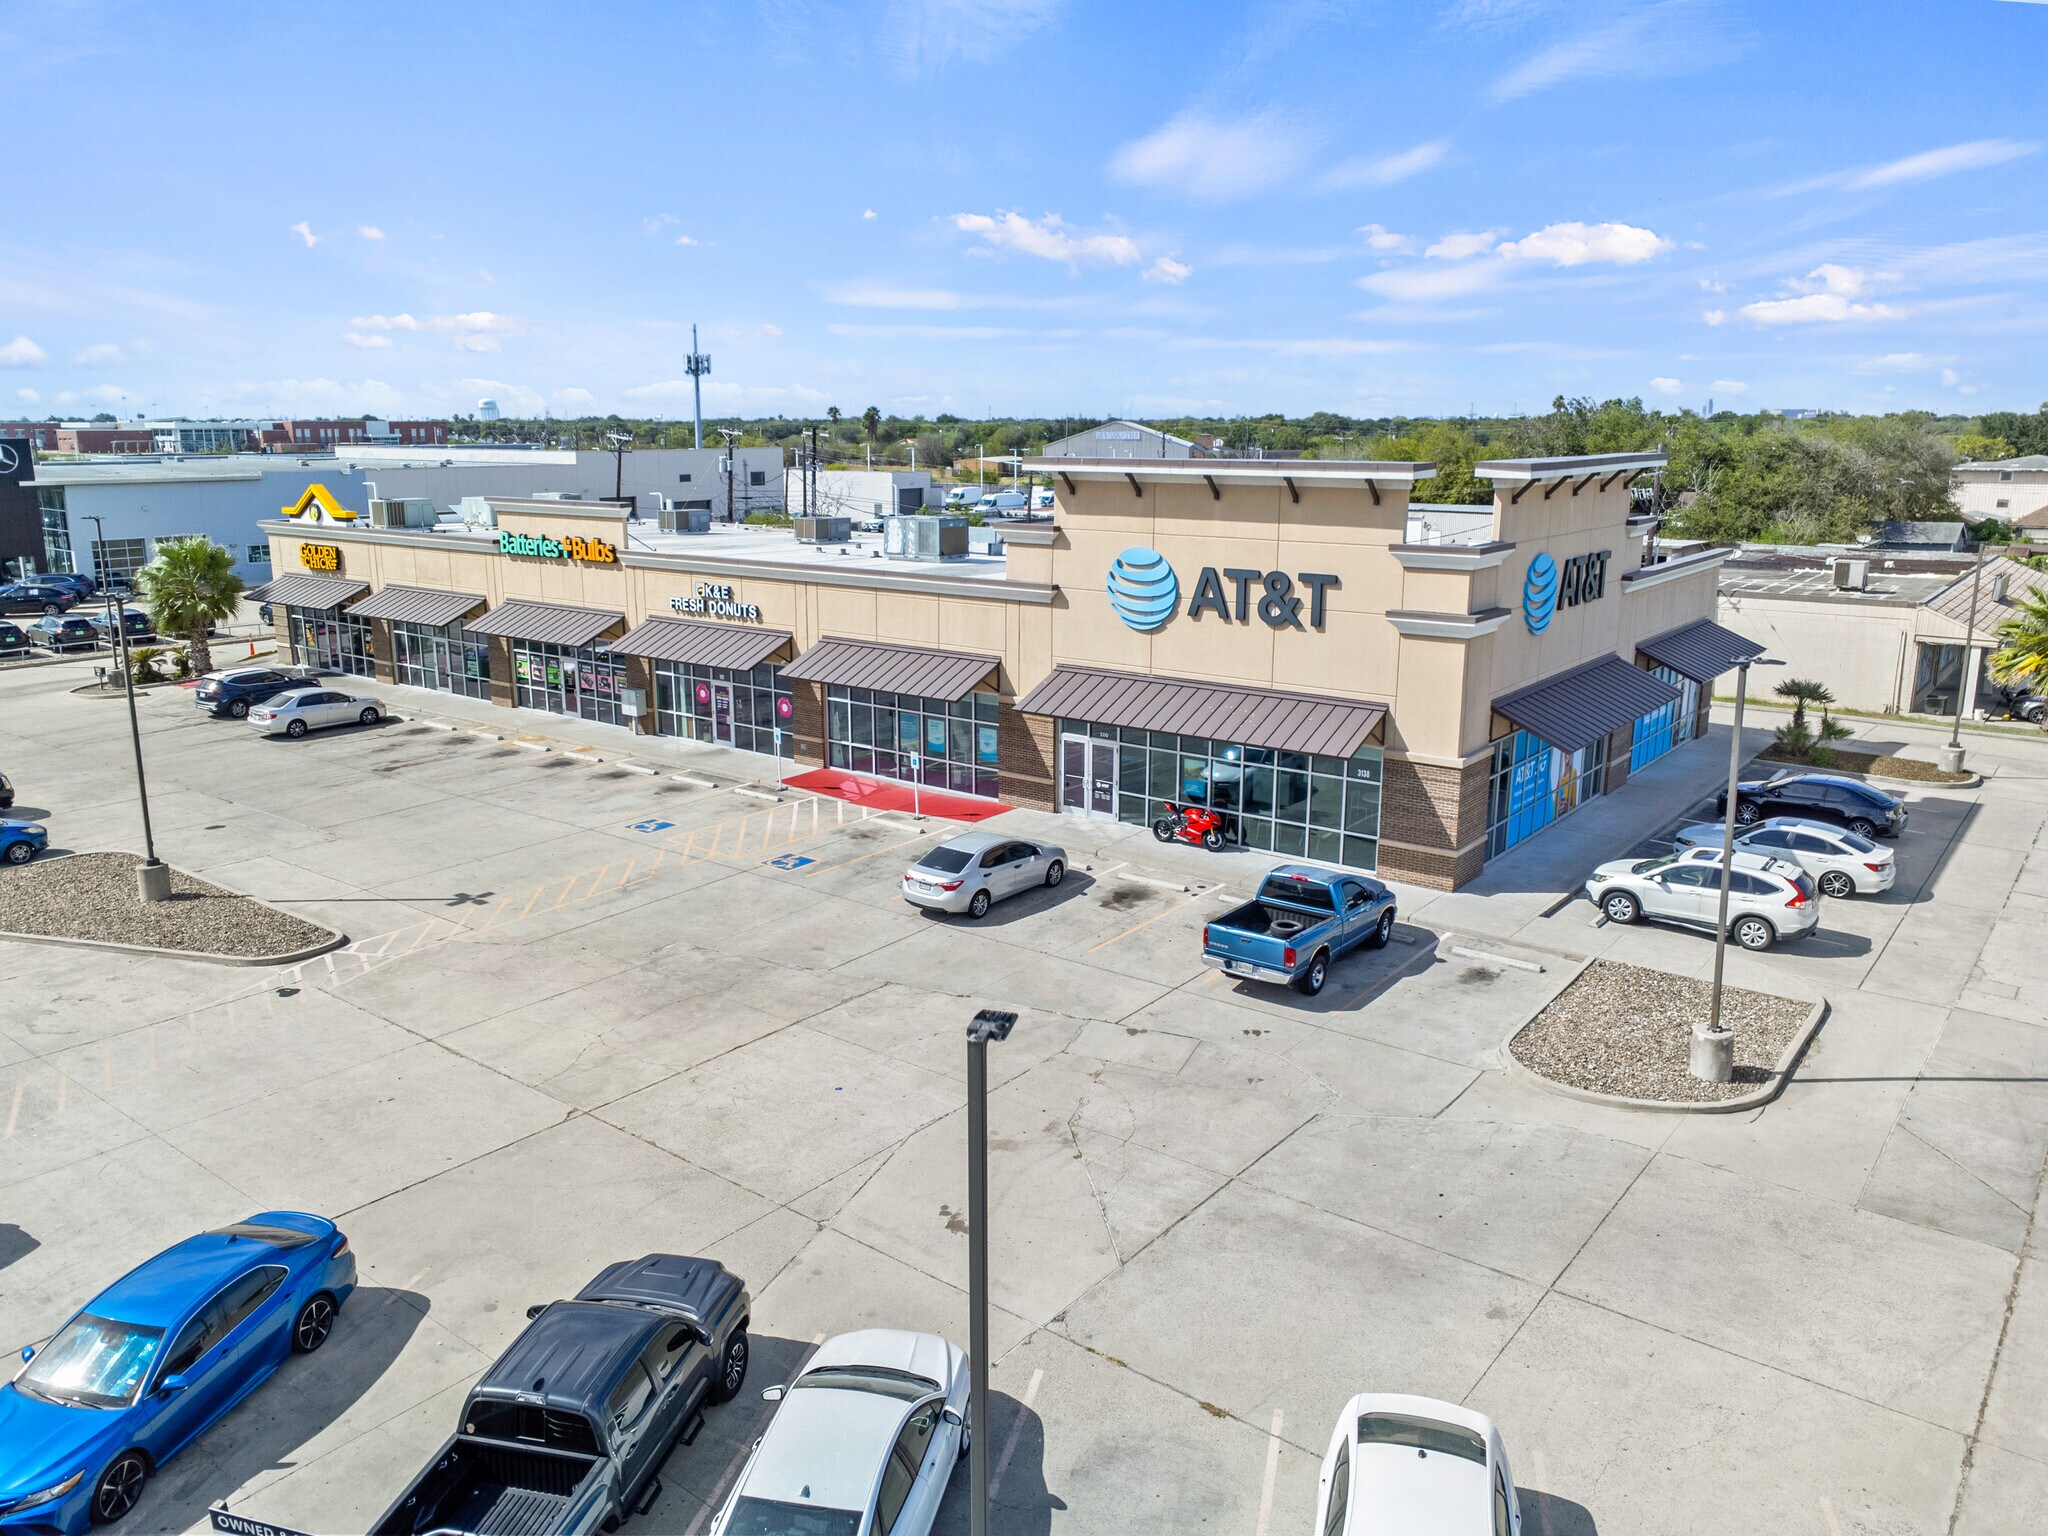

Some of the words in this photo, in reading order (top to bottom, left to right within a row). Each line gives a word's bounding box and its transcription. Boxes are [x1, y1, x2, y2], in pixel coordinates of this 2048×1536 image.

[300, 544, 336, 559] GOLDEN
[304, 556, 336, 570] CHICK
[1556, 550, 1612, 610] AT&T
[705, 584, 729, 599] K&E
[1187, 566, 1338, 628] AT&T
[669, 597, 704, 613] FRESH
[709, 600, 757, 619] DONUTS
[1357, 768, 1370, 778] 3138
[217, 1515, 274, 1536] OWNED
